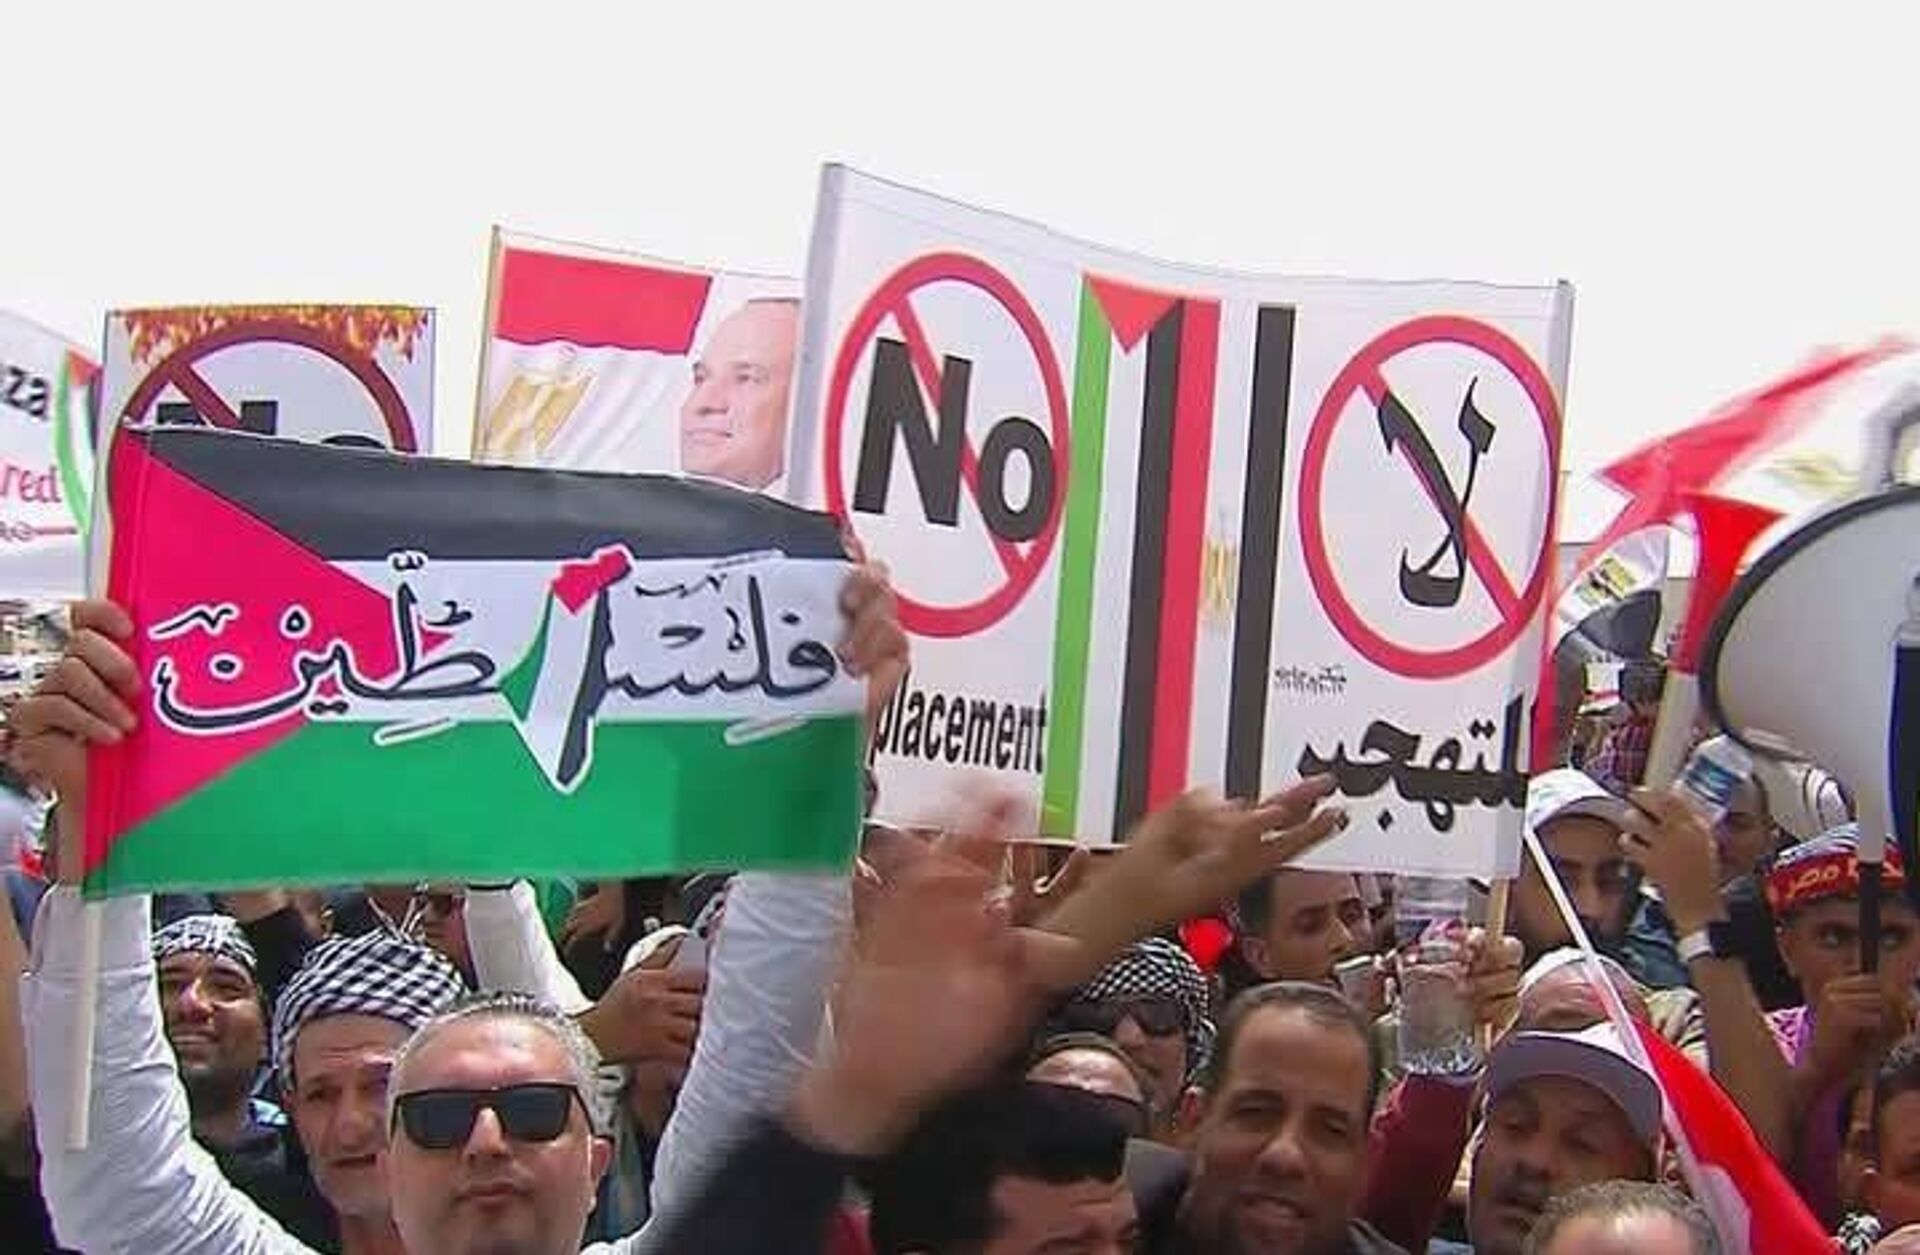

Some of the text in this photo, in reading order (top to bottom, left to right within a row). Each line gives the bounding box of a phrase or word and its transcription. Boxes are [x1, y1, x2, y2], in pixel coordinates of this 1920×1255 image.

[852, 335, 1055, 543] No
[1378, 375, 1497, 609] لا
[1297, 693, 1529, 833] لتهجير
